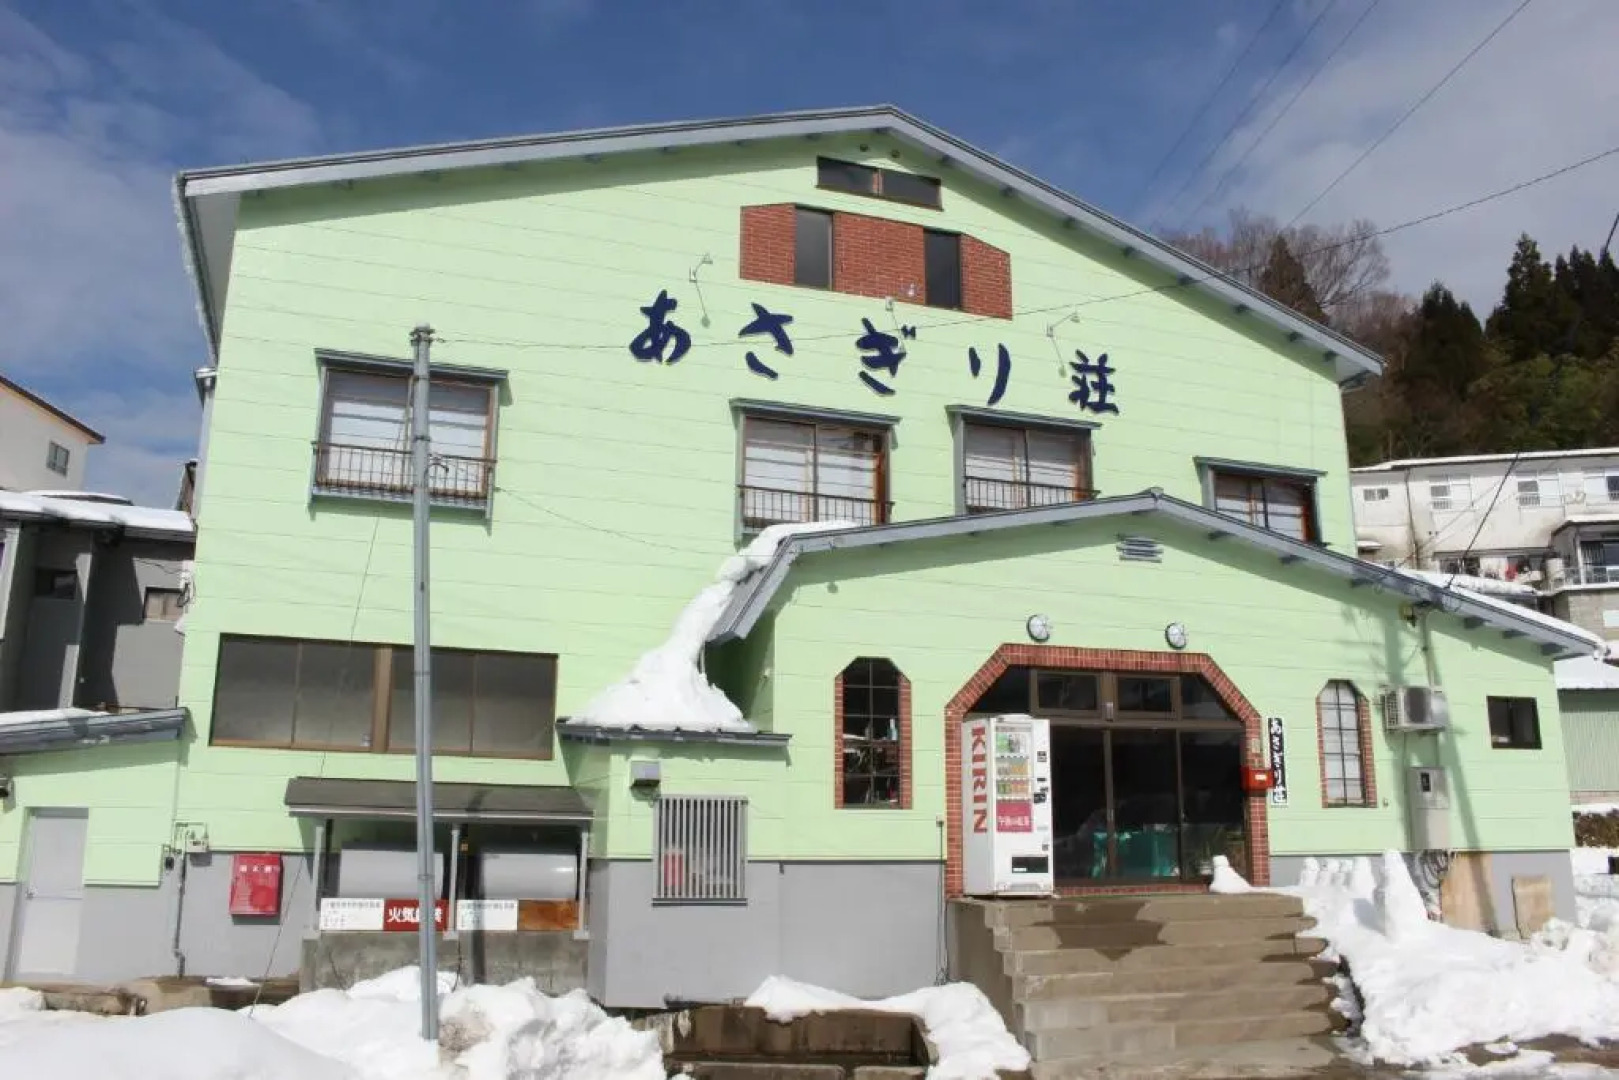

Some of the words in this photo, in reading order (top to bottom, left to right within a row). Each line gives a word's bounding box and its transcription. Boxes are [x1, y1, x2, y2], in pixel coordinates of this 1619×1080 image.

[629, 289, 1119, 413] あさぎり荘
[971, 727, 988, 833] KIRIN
[387, 906, 442, 923] 火気
